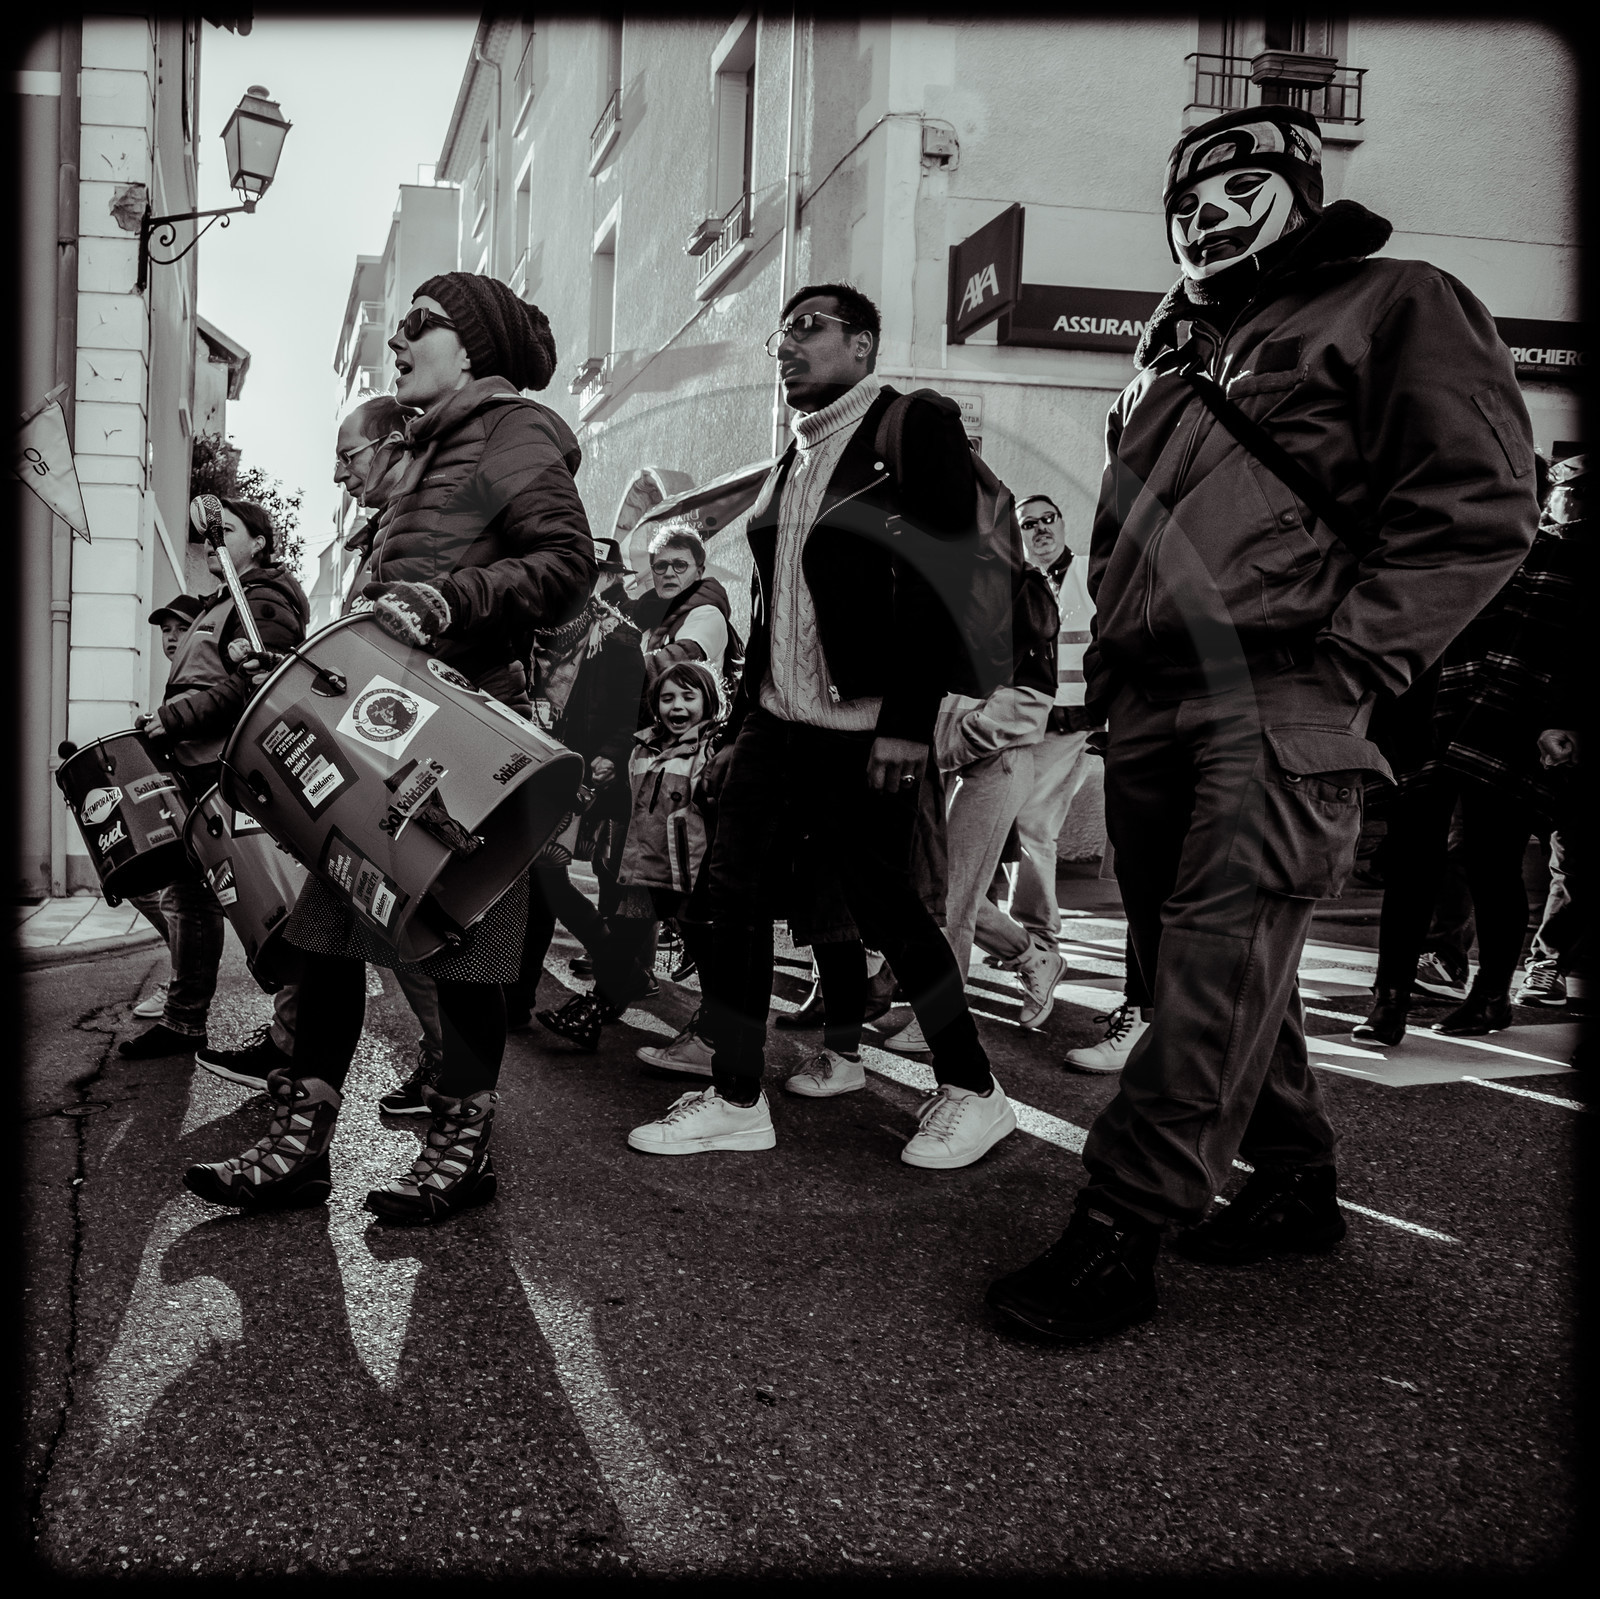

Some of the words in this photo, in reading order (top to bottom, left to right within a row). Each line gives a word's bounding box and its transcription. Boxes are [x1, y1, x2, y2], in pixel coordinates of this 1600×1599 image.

[957, 263, 1000, 321] AXA
[23, 447, 51, 477] 05
[308, 772, 335, 797] Solidaires
[492, 755, 533, 785] Solidaires
[396, 773, 438, 813] Solidaires
